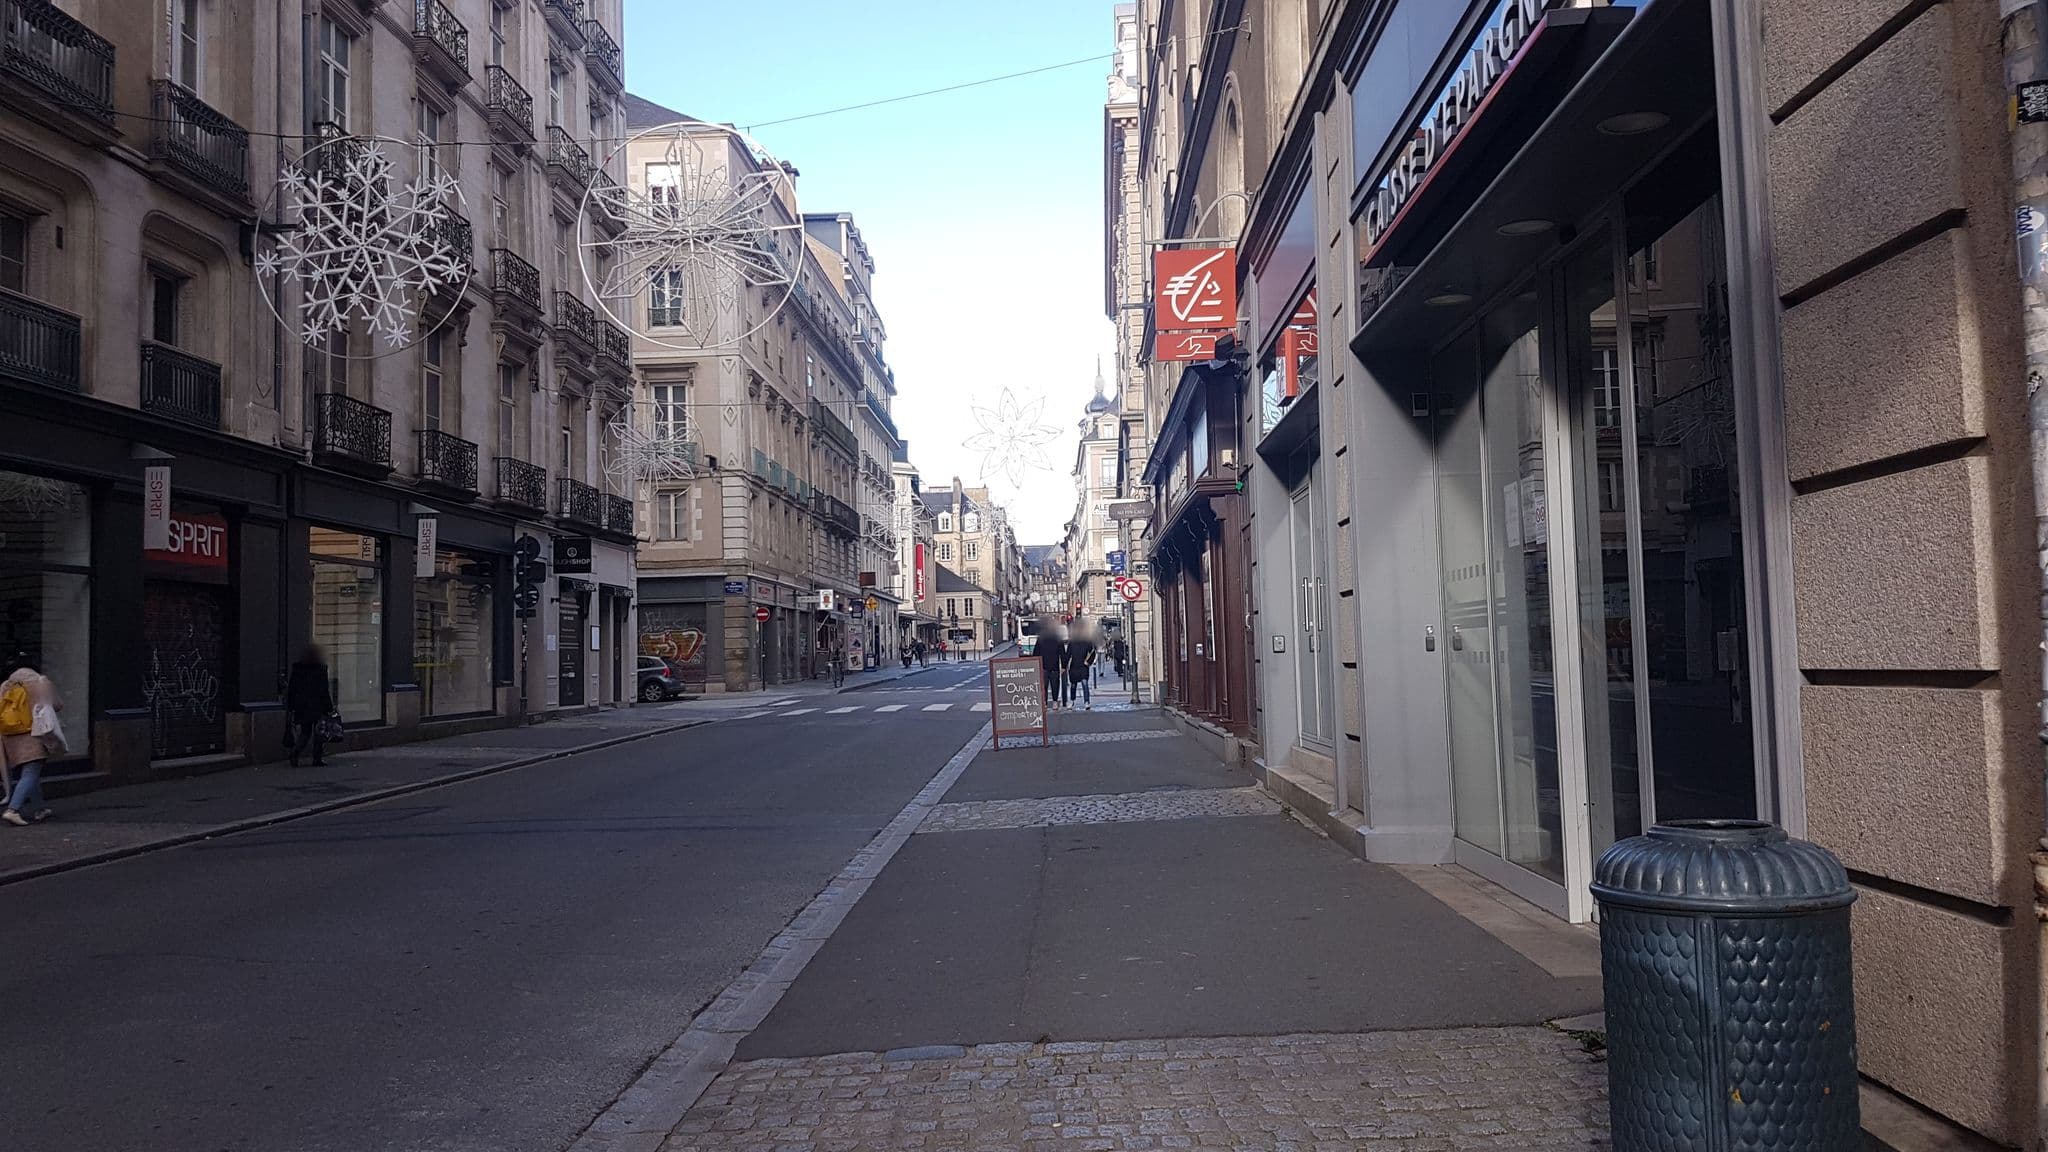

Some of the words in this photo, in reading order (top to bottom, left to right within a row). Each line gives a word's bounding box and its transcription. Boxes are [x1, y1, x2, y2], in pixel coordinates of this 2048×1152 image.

[1367, 136, 1425, 246] CAISSE
[1424, 0, 1550, 172] D'EPARGN
[150, 471, 163, 520] ESPRIT
[168, 519, 225, 557] SPRIT
[422, 521, 432, 556] ESPRIT
